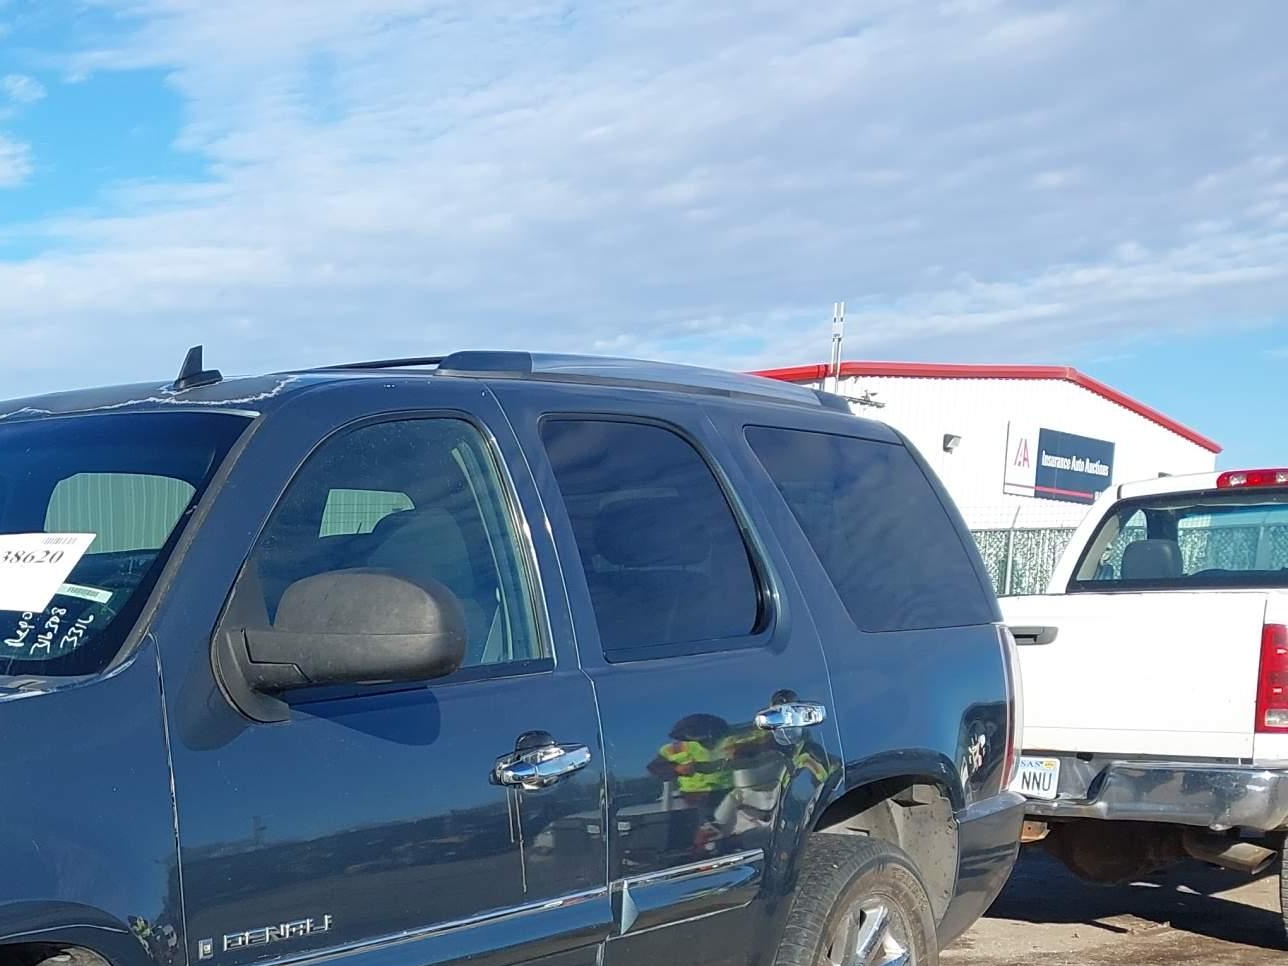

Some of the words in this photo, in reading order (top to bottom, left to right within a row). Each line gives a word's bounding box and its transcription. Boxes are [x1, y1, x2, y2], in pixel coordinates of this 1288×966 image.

[1041, 449, 1070, 470] Insurance
[1070, 455, 1084, 473] Auto
[1084, 457, 1110, 477] Auctions
[1021, 771, 1052, 791] NNU
